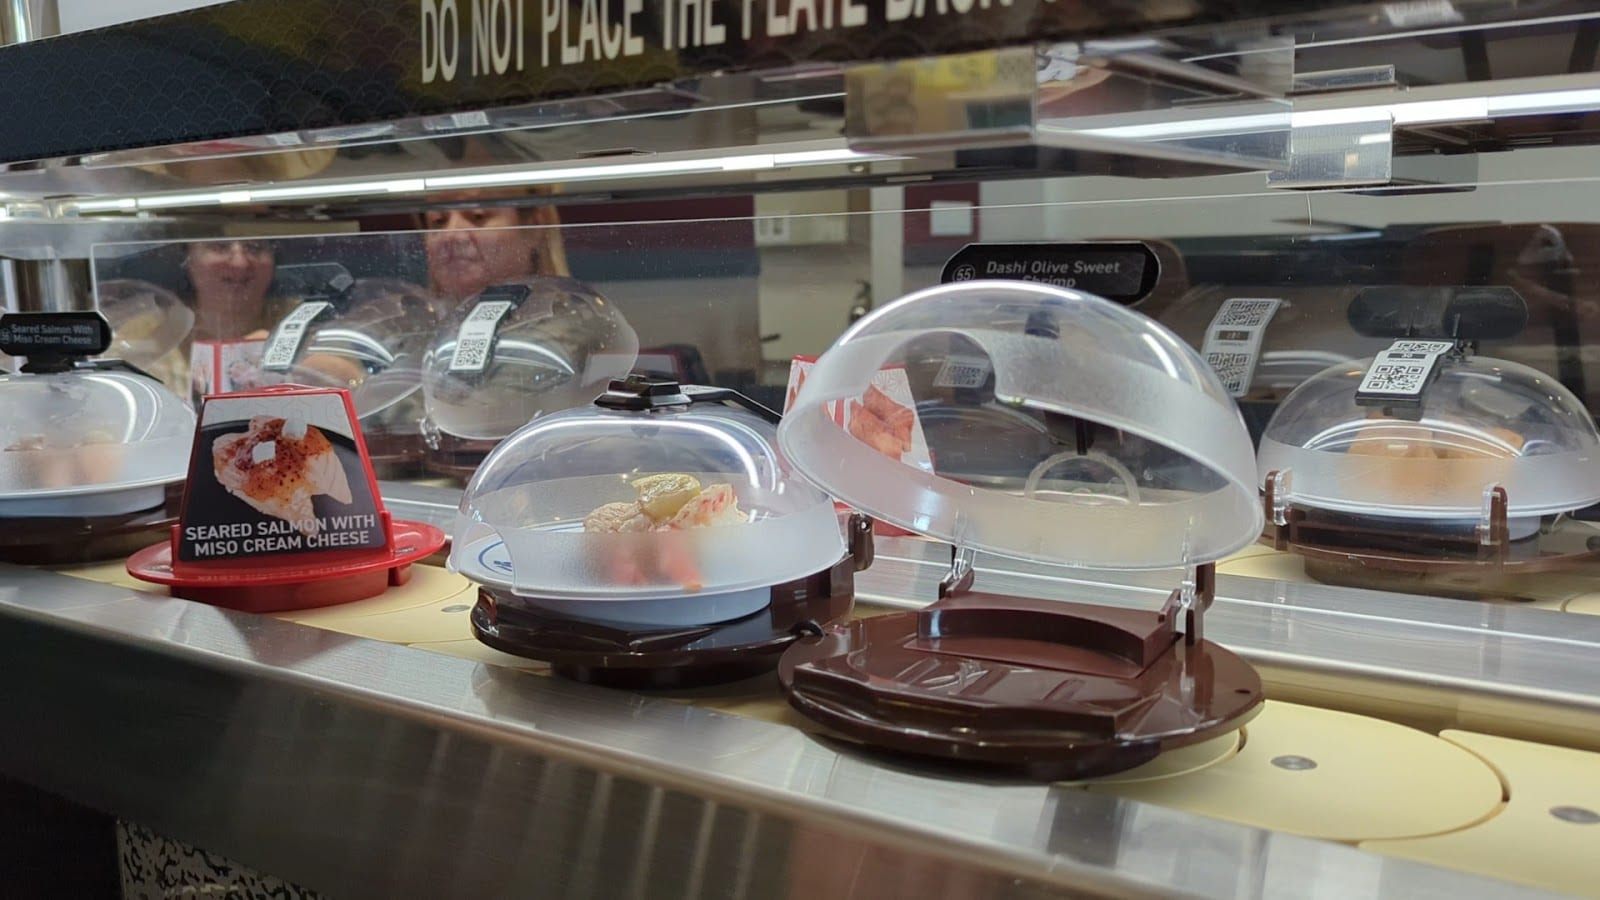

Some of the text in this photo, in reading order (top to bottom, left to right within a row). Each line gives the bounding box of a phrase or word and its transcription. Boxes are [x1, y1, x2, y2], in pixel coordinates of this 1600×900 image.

[421, 0, 459, 84] DO
[472, 0, 524, 77] NOT
[541, 0, 644, 67] PLACE
[986, 261, 1121, 274] Dashi Olive Sweet
[185, 514, 376, 541] SEARED SALMON WITH
[194, 530, 370, 557] MISO CREAM CHEESE
